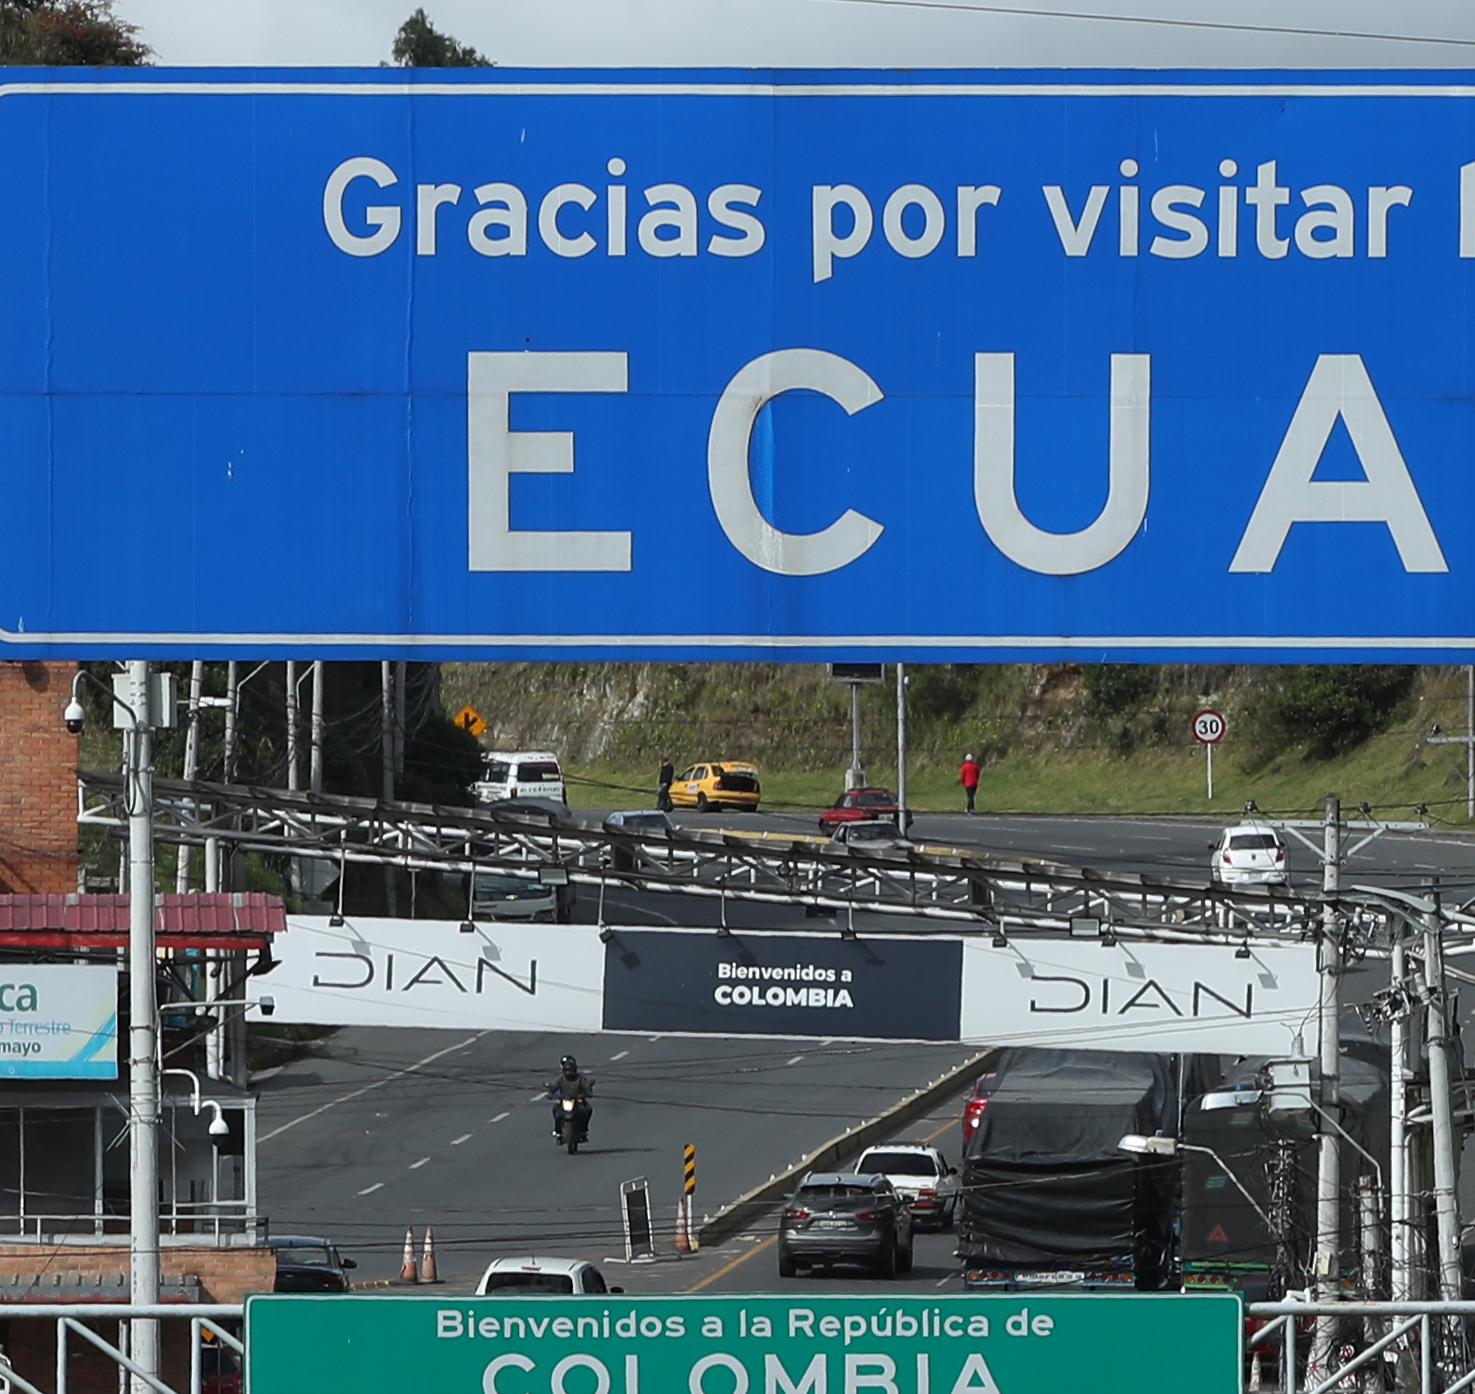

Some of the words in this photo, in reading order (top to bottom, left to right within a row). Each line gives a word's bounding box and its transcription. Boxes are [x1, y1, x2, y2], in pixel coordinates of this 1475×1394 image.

[324, 158, 774, 258] Gracias
[813, 185, 1001, 284] por
[1043, 159, 1412, 258] visitar
[1198, 719, 1220, 735] 30
[313, 952, 537, 995] DIAN
[718, 962, 836, 982] Bienvenidos
[840, 968, 853, 982] a
[714, 986, 855, 1008] COLOMBIA
[1030, 975, 1252, 1018] DIAN
[8, 1018, 71, 1035] Terrestre
[437, 1309, 686, 1338] Bienvenidos
[702, 1316, 724, 1337] a
[740, 1309, 773, 1337] la
[789, 1307, 990, 1346] República
[1006, 1308, 1055, 1336] de
